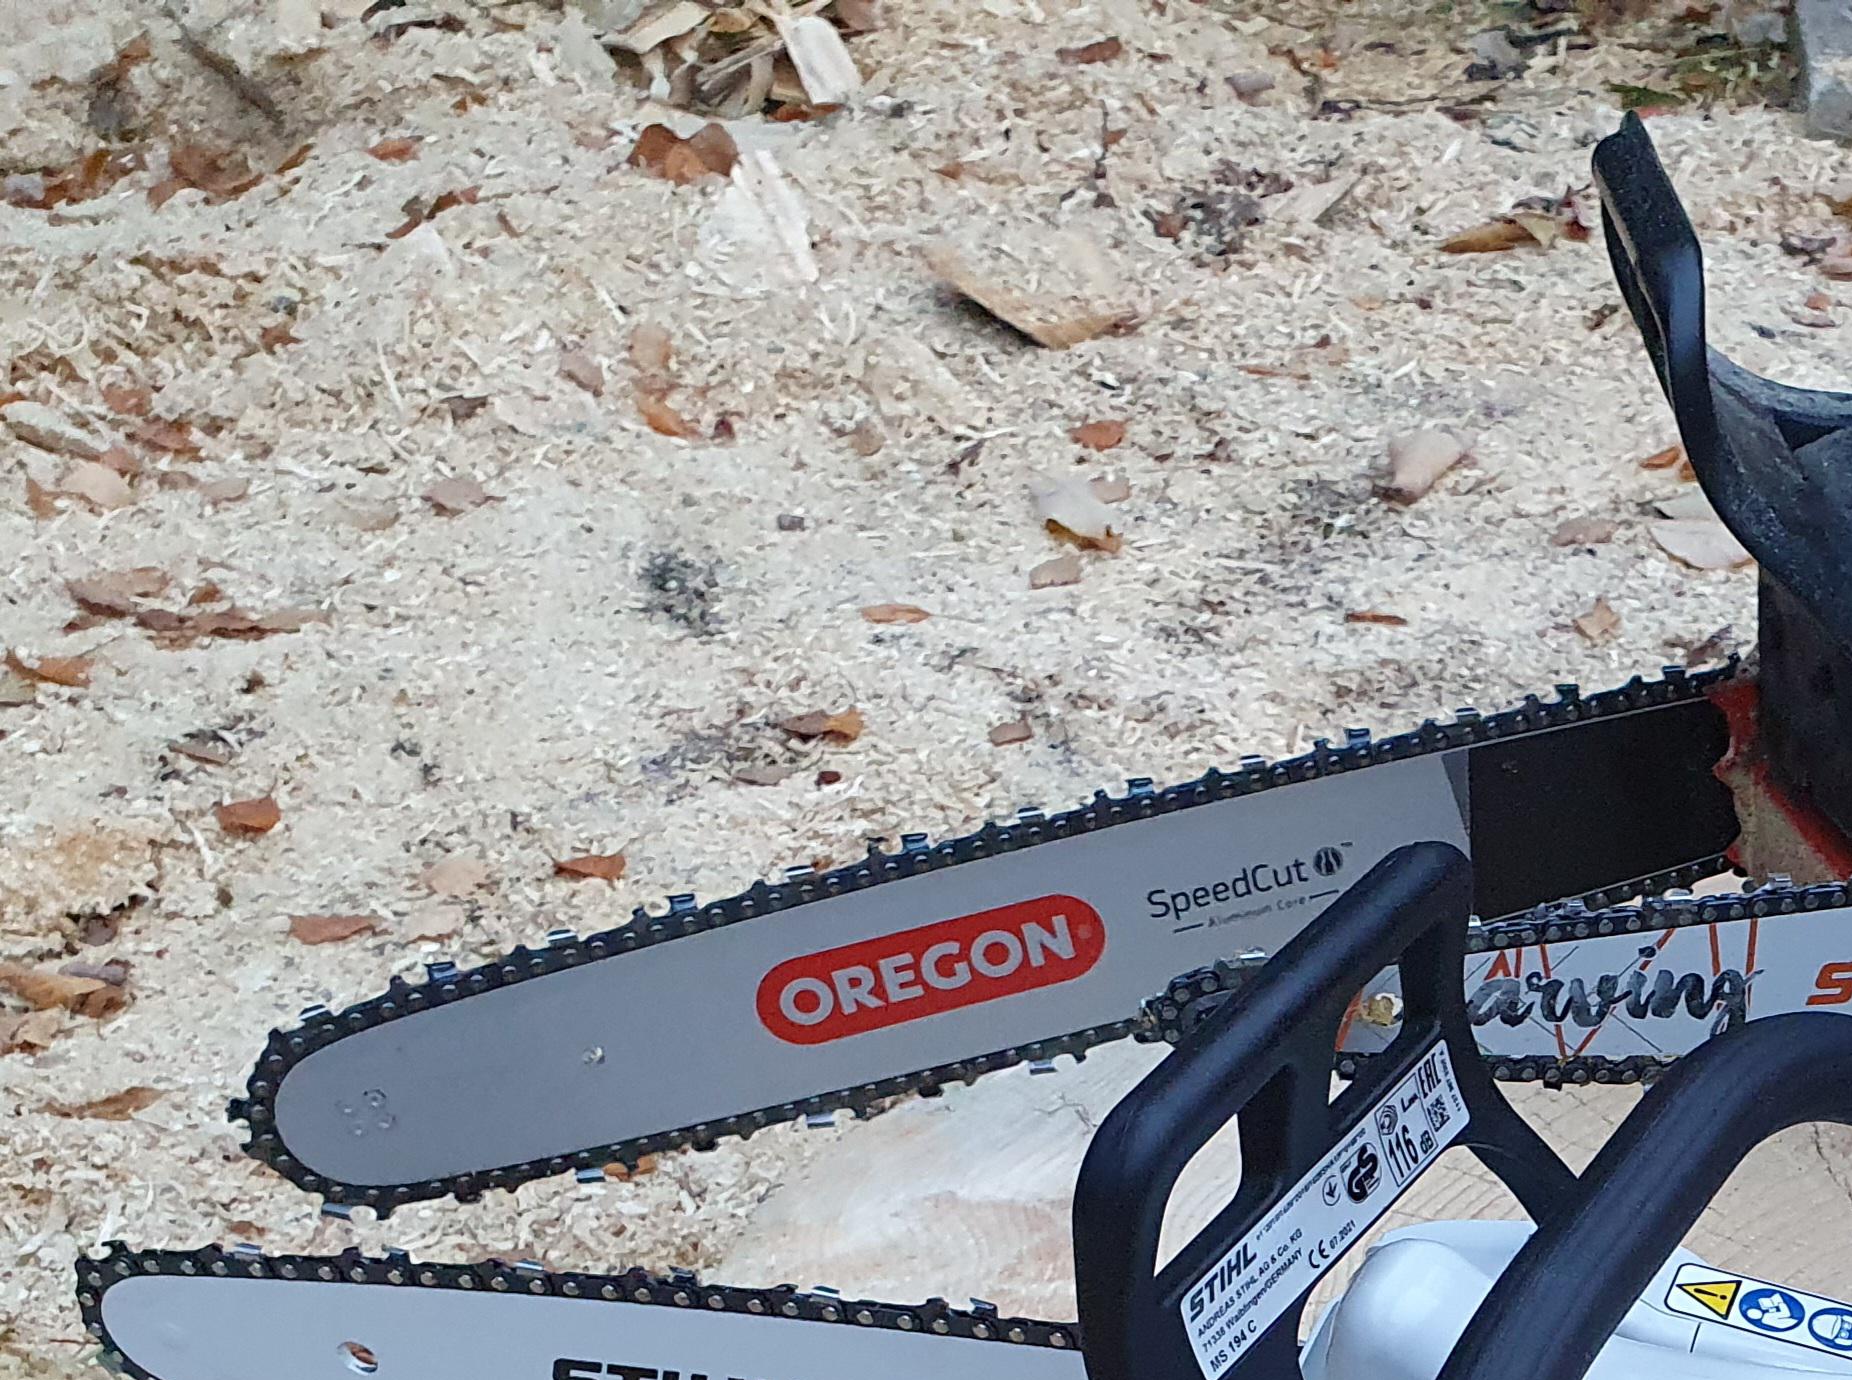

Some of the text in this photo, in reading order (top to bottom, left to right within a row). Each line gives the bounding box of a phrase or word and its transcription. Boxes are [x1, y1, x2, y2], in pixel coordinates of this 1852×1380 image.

[1147, 858, 1309, 921] SpeedCut
[778, 914, 1077, 1026] OREGON
[1464, 946, 1764, 1038] arving
[1388, 1124, 1419, 1178] 116
[1420, 1130, 1434, 1155] dB
[1189, 1242, 1258, 1323] STIHL
[1197, 1295, 1236, 1338] ANDREAS
[1236, 1274, 1258, 1300] STIHL
[1258, 1261, 1271, 1278] AG
[1289, 1228, 1303, 1245] KG
[1209, 1320, 1258, 1372] MS 194 C
